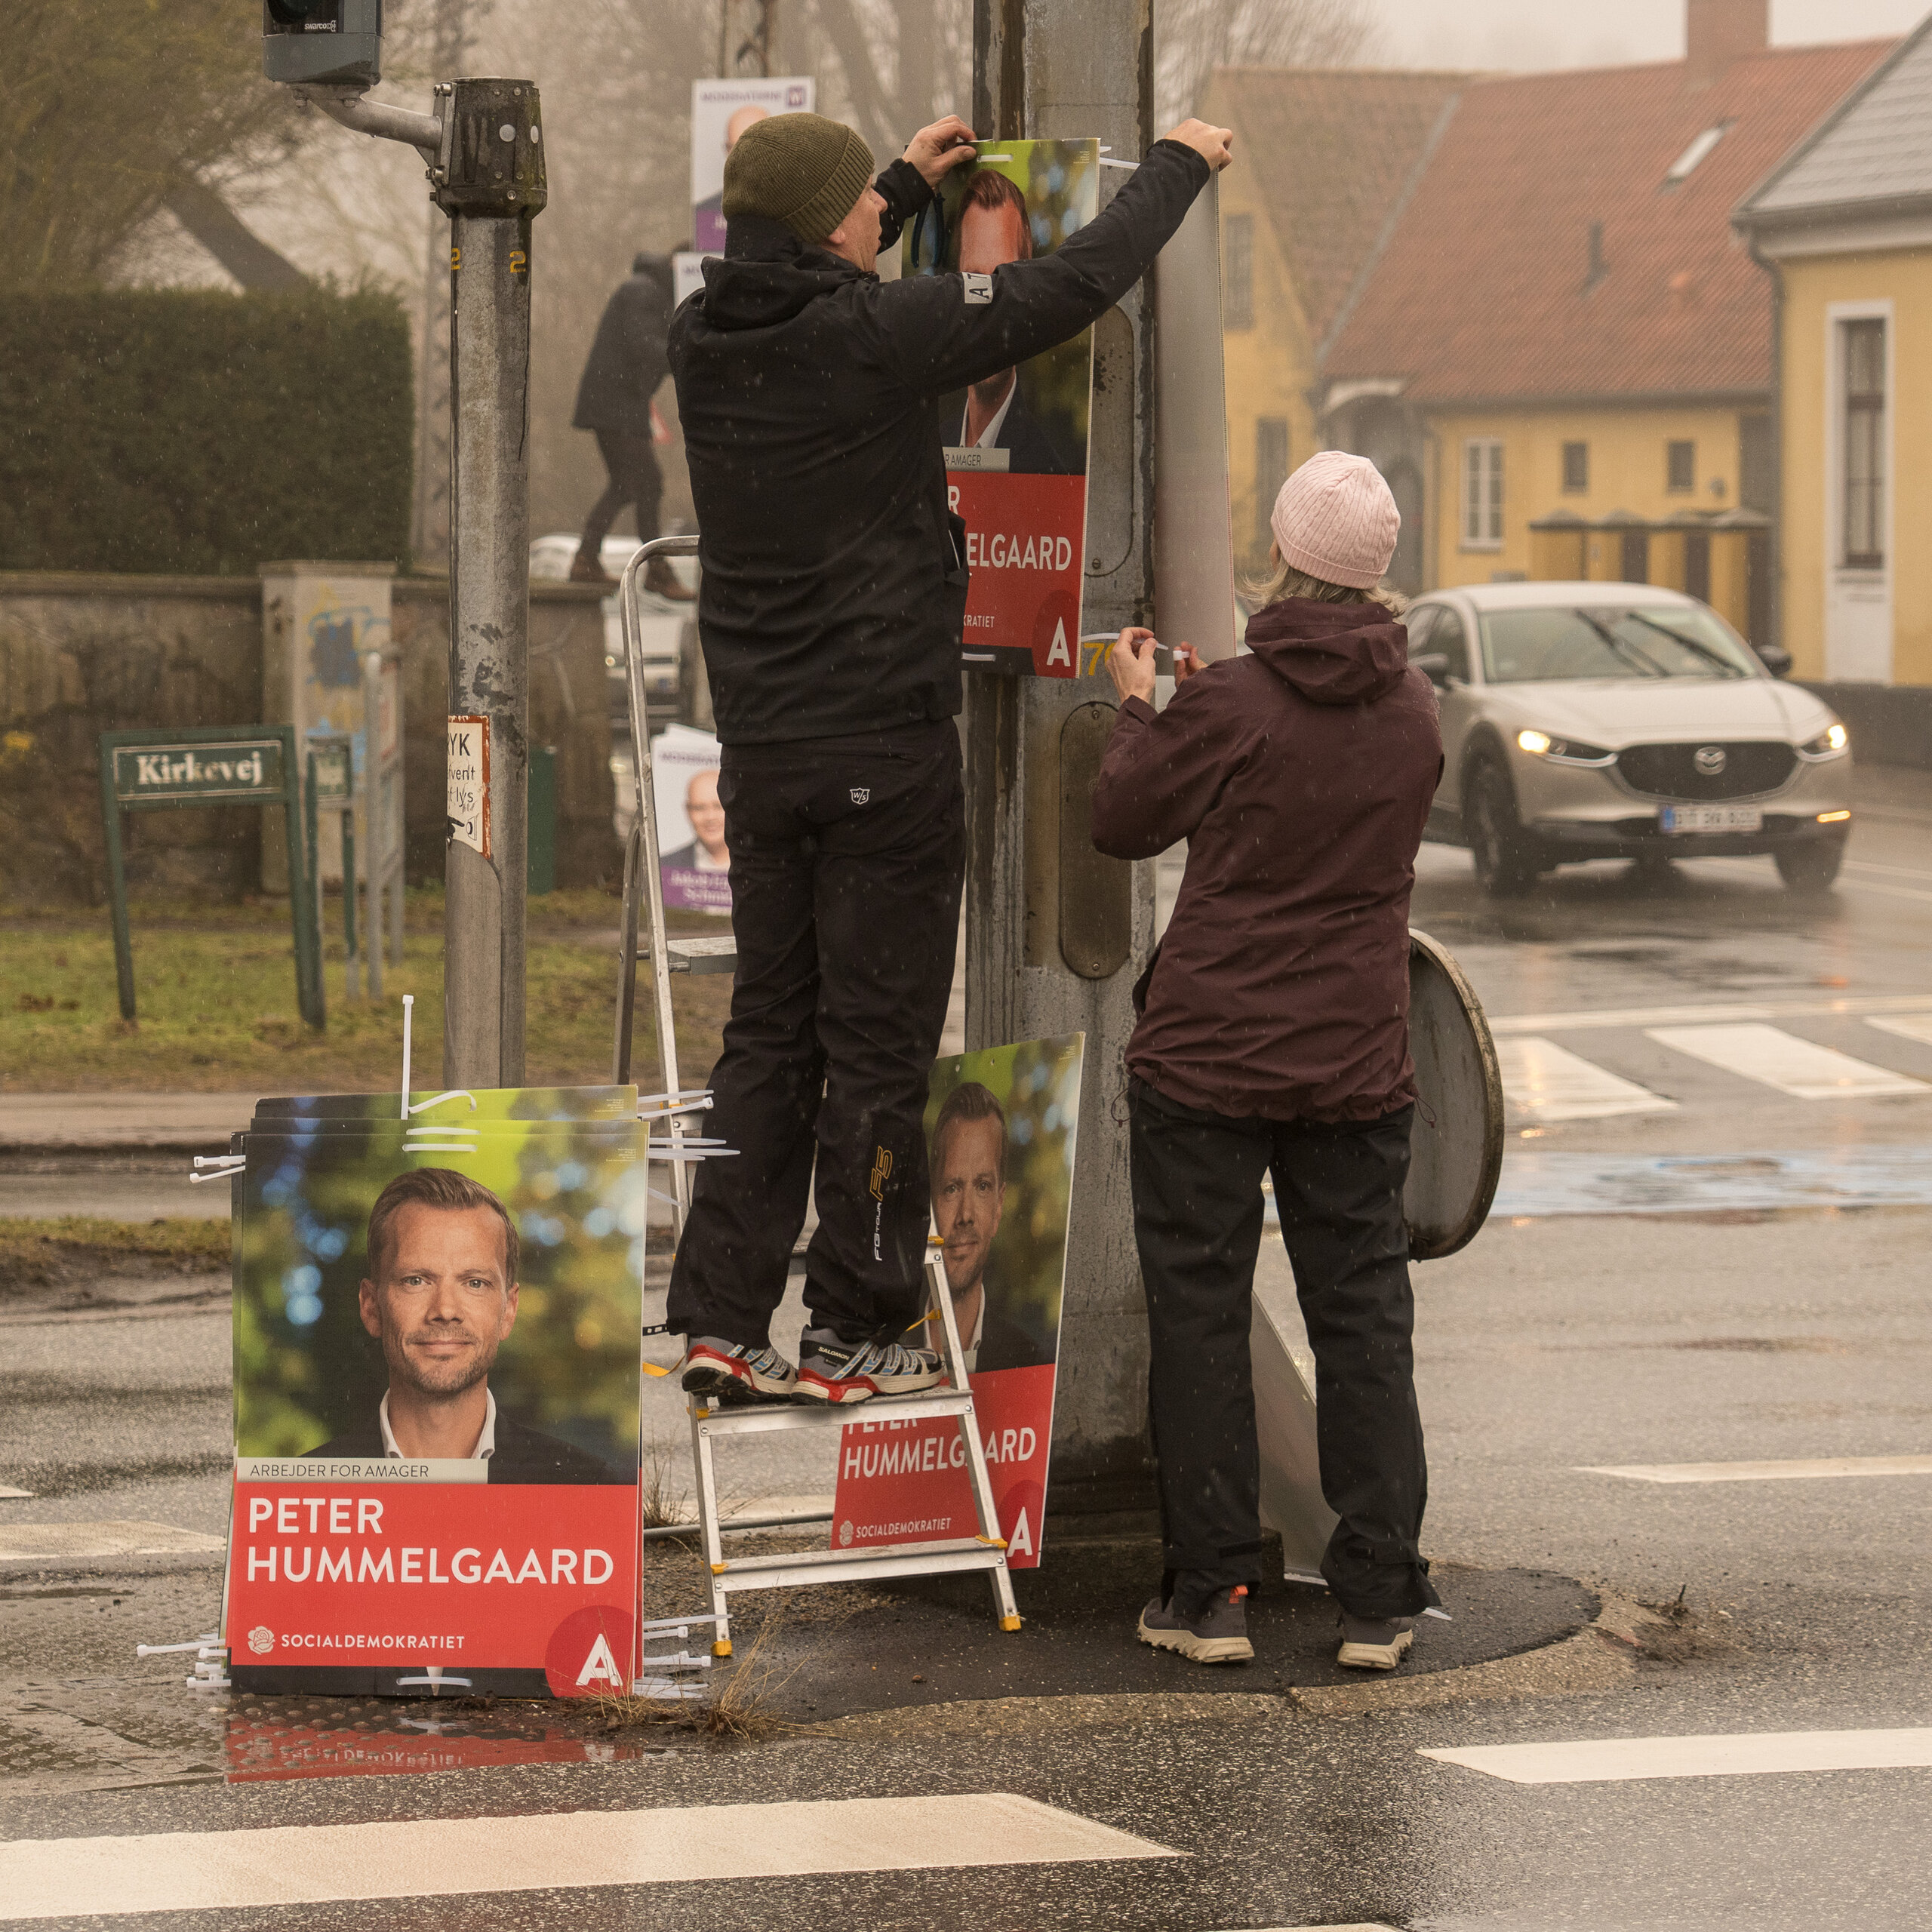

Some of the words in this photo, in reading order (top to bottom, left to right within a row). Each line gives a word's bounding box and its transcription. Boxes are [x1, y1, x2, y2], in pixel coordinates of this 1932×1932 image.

[509, 250, 526, 272] 2
[951, 454, 981, 466] AMAGER
[1047, 617, 1071, 667] A
[448, 733, 470, 755] YK
[456, 786, 473, 807] lys
[818, 1346, 850, 1360] SALOMON
[844, 1427, 1036, 1479] HUMMELGARD
[250, 1464, 325, 1477] ARBEJDER
[331, 1465, 361, 1477] FOR
[365, 1465, 429, 1478] AMAGER
[249, 1497, 383, 1534] PETER
[856, 1518, 952, 1538] SOCIALDEMOKRATIET
[1006, 1506, 1032, 1557] A
[248, 1546, 614, 1585] HUMMELGAARD
[281, 1634, 465, 1650] SOCIALDEMOKRATIET
[575, 1633, 623, 1687] A
